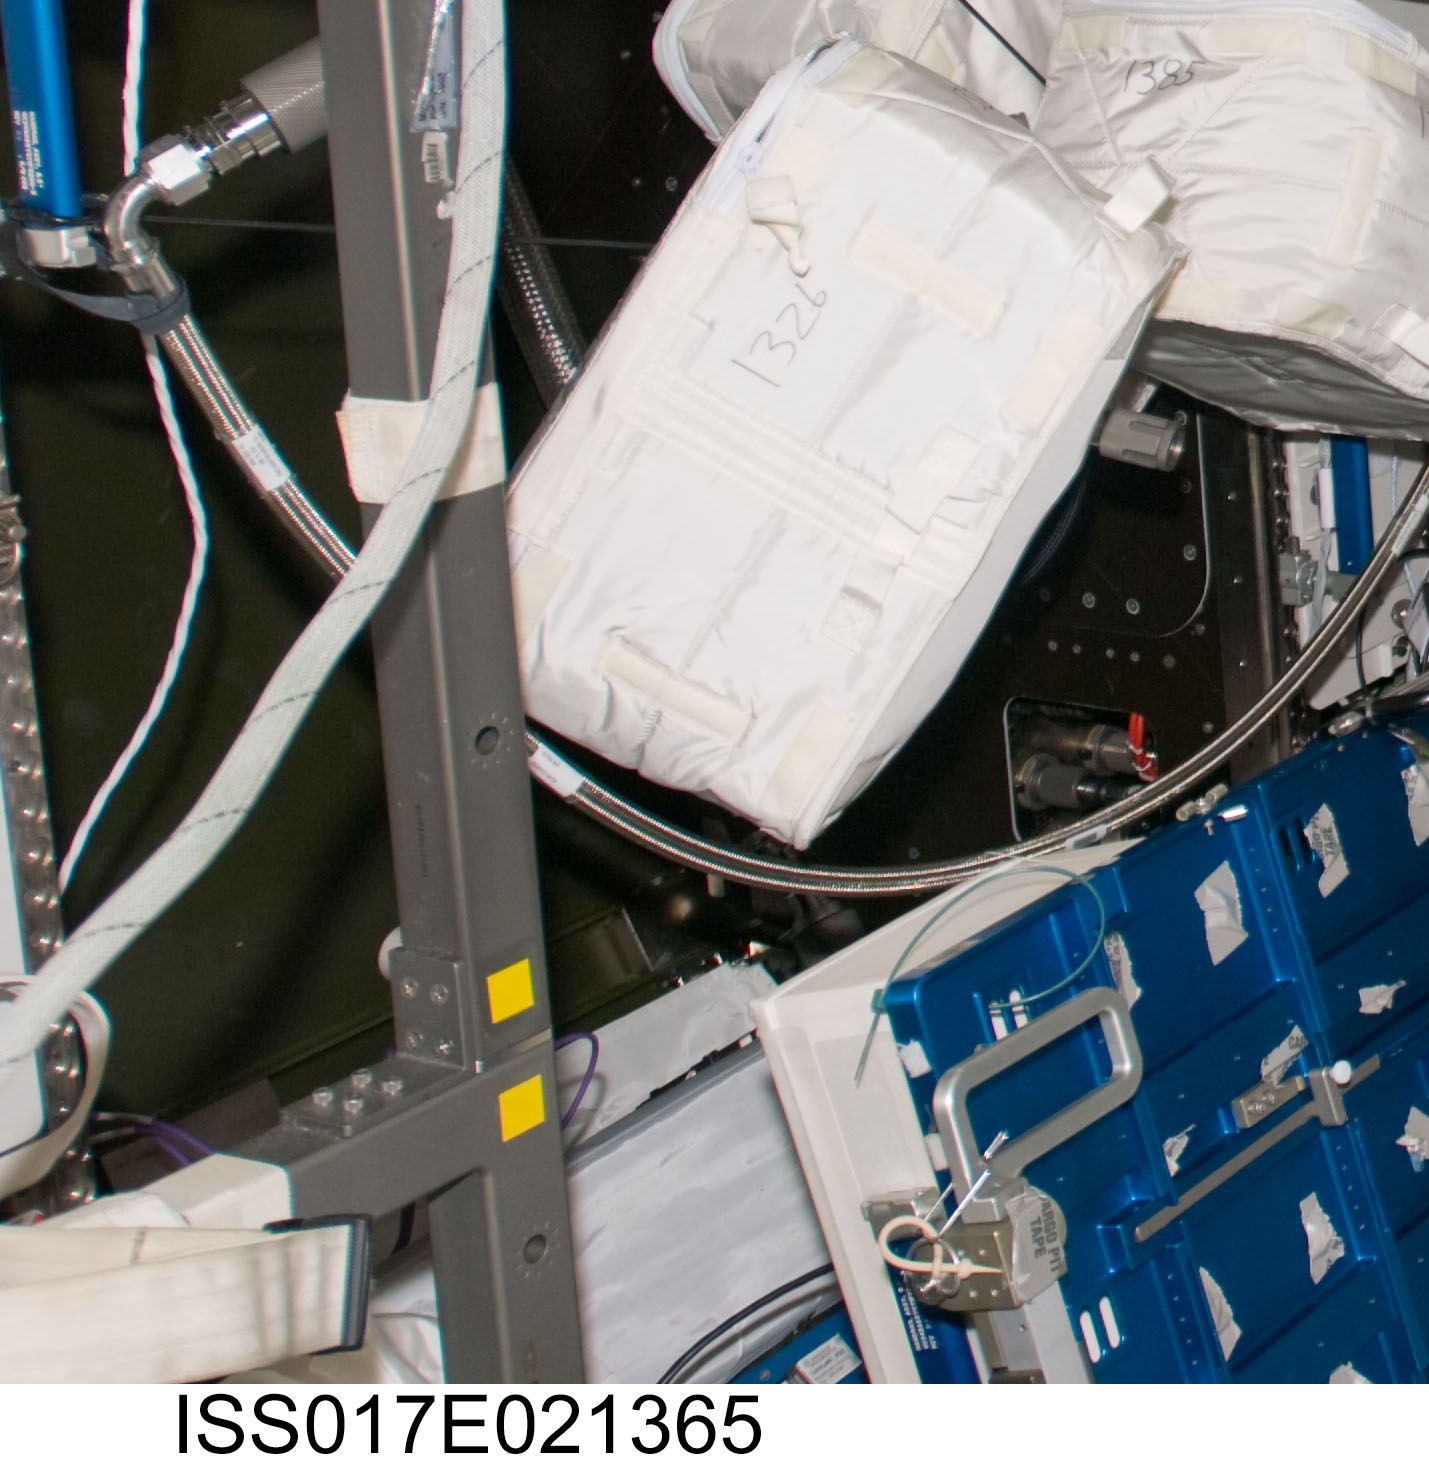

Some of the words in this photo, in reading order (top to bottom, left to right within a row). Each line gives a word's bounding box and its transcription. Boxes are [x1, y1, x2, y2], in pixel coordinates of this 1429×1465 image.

[1124, 59, 1206, 96] 1385
[731, 283, 827, 388] 1326
[1030, 1216, 1047, 1259] TAPE
